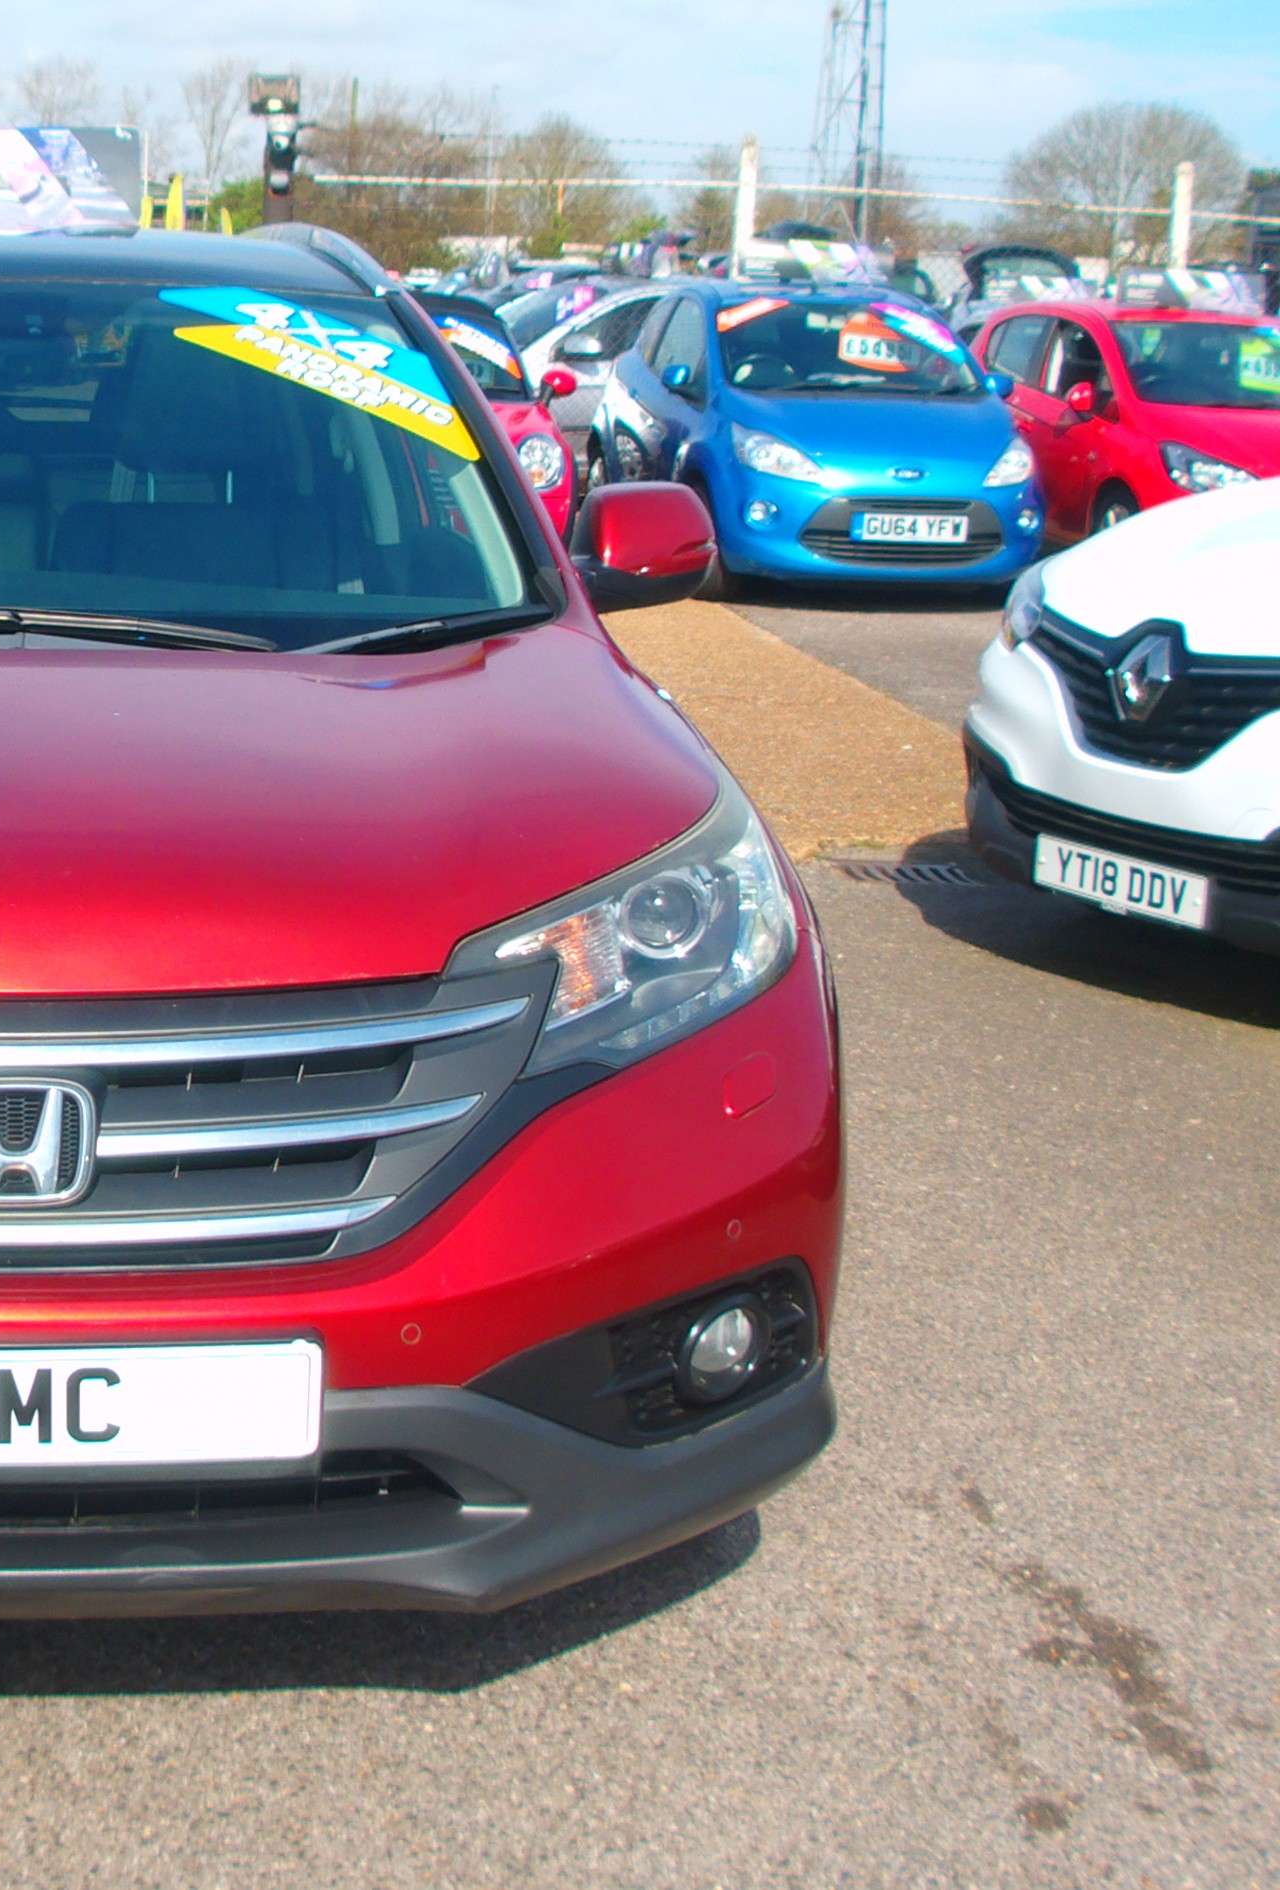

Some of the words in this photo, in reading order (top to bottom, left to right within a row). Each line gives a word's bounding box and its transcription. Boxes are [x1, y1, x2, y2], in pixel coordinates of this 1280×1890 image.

[234, 326, 453, 425] PANORAMIC
[276, 358, 384, 407] ROOF
[867, 517, 918, 536] GU64
[1057, 847, 1118, 896] YT18
[1127, 866, 1187, 914] DDV
